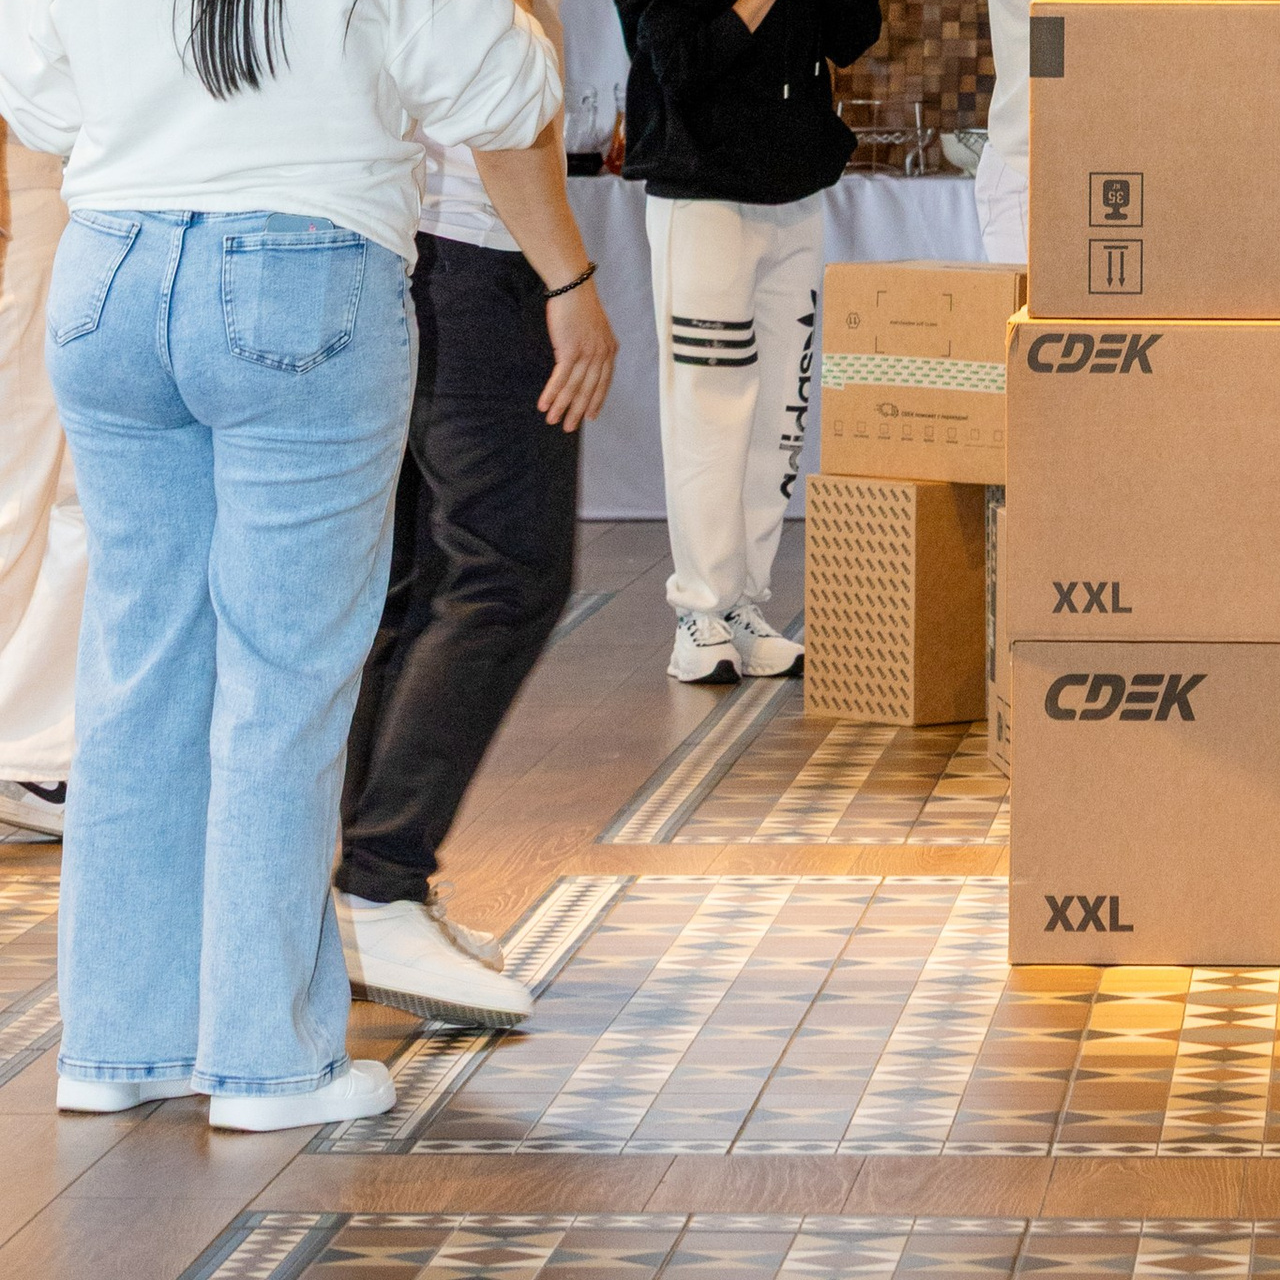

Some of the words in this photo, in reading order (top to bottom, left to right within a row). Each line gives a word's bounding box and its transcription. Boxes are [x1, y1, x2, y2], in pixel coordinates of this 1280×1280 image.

[1108, 191, 1124, 204] 35
[1027, 334, 1162, 373] CDEK
[1053, 582, 1132, 613] XXL
[1045, 674, 1207, 721] CDEK
[1045, 896, 1133, 931] XXL
